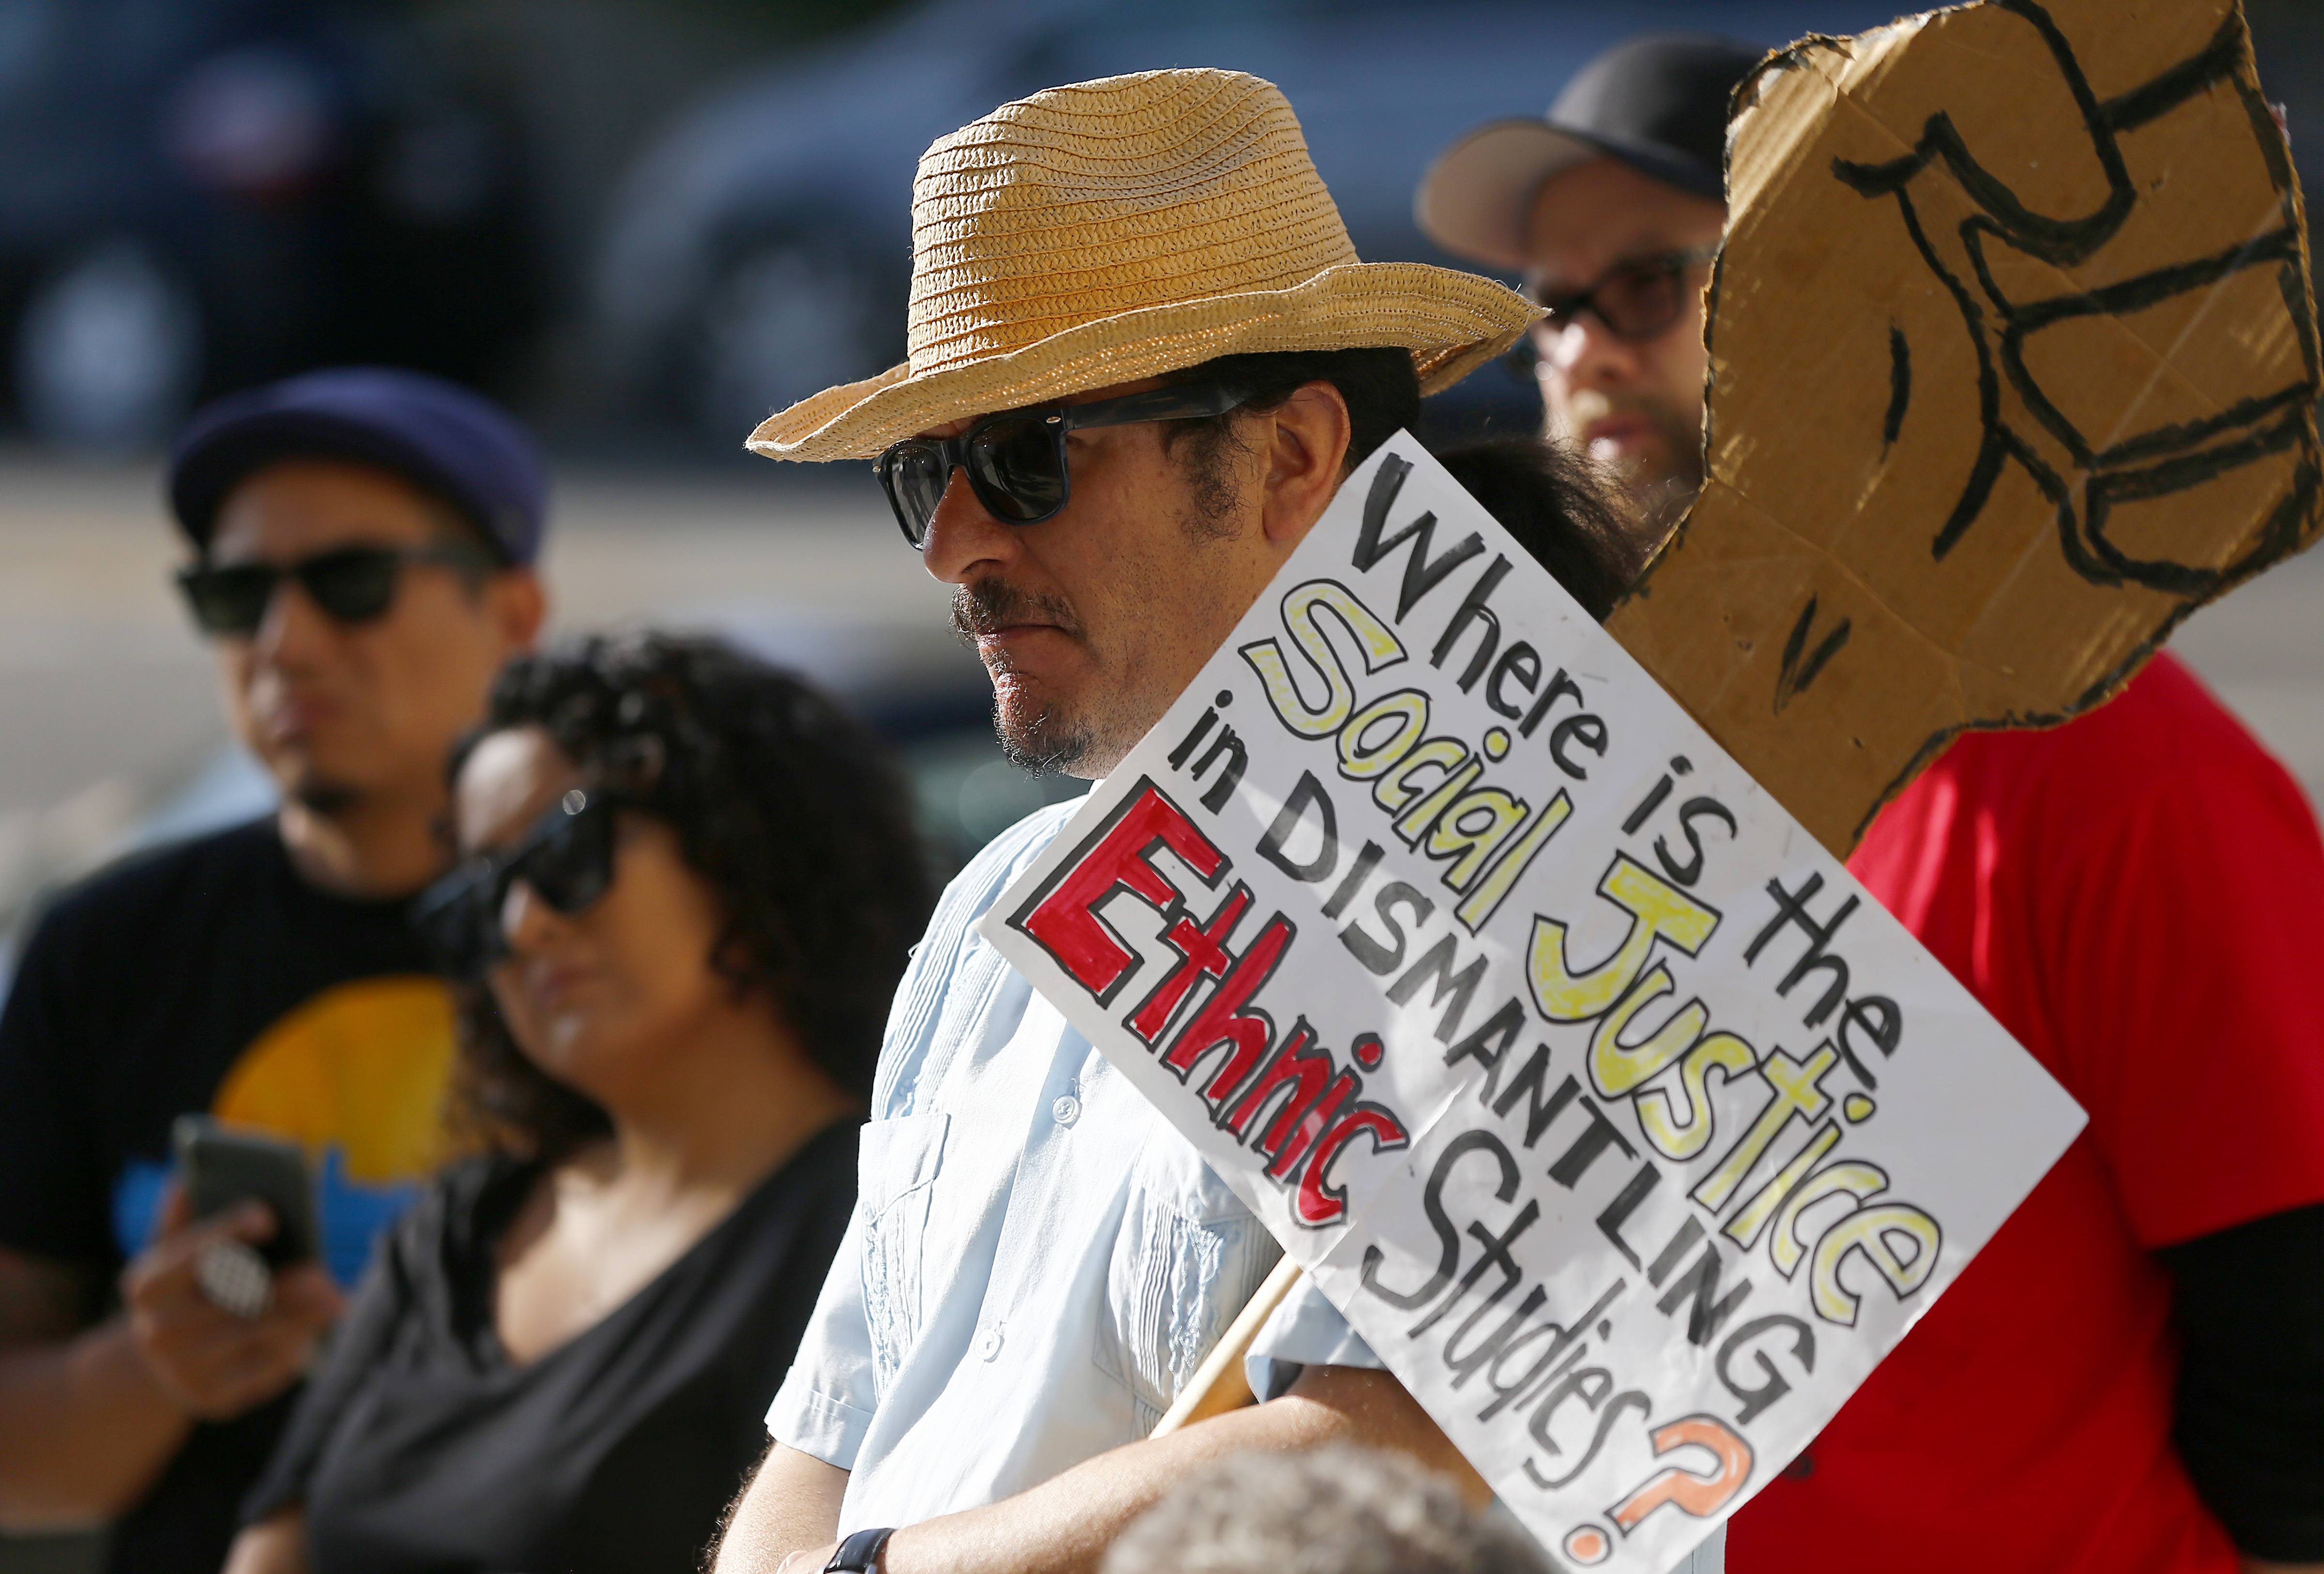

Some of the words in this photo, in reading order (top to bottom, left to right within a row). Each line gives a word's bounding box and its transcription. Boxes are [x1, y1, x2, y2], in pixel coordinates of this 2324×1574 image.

[1166, 690, 1250, 816] in
[1254, 769, 1815, 1426] DISMANTLING
[1238, 578, 1573, 936] Social
[1525, 851, 1941, 1327] Justice
[1352, 452, 1610, 782] Where
[1620, 755, 1739, 885] is
[1743, 871, 1903, 1092] the
[1007, 774, 1411, 1229] Ethnic
[1361, 1128, 1754, 1566] Studies?
